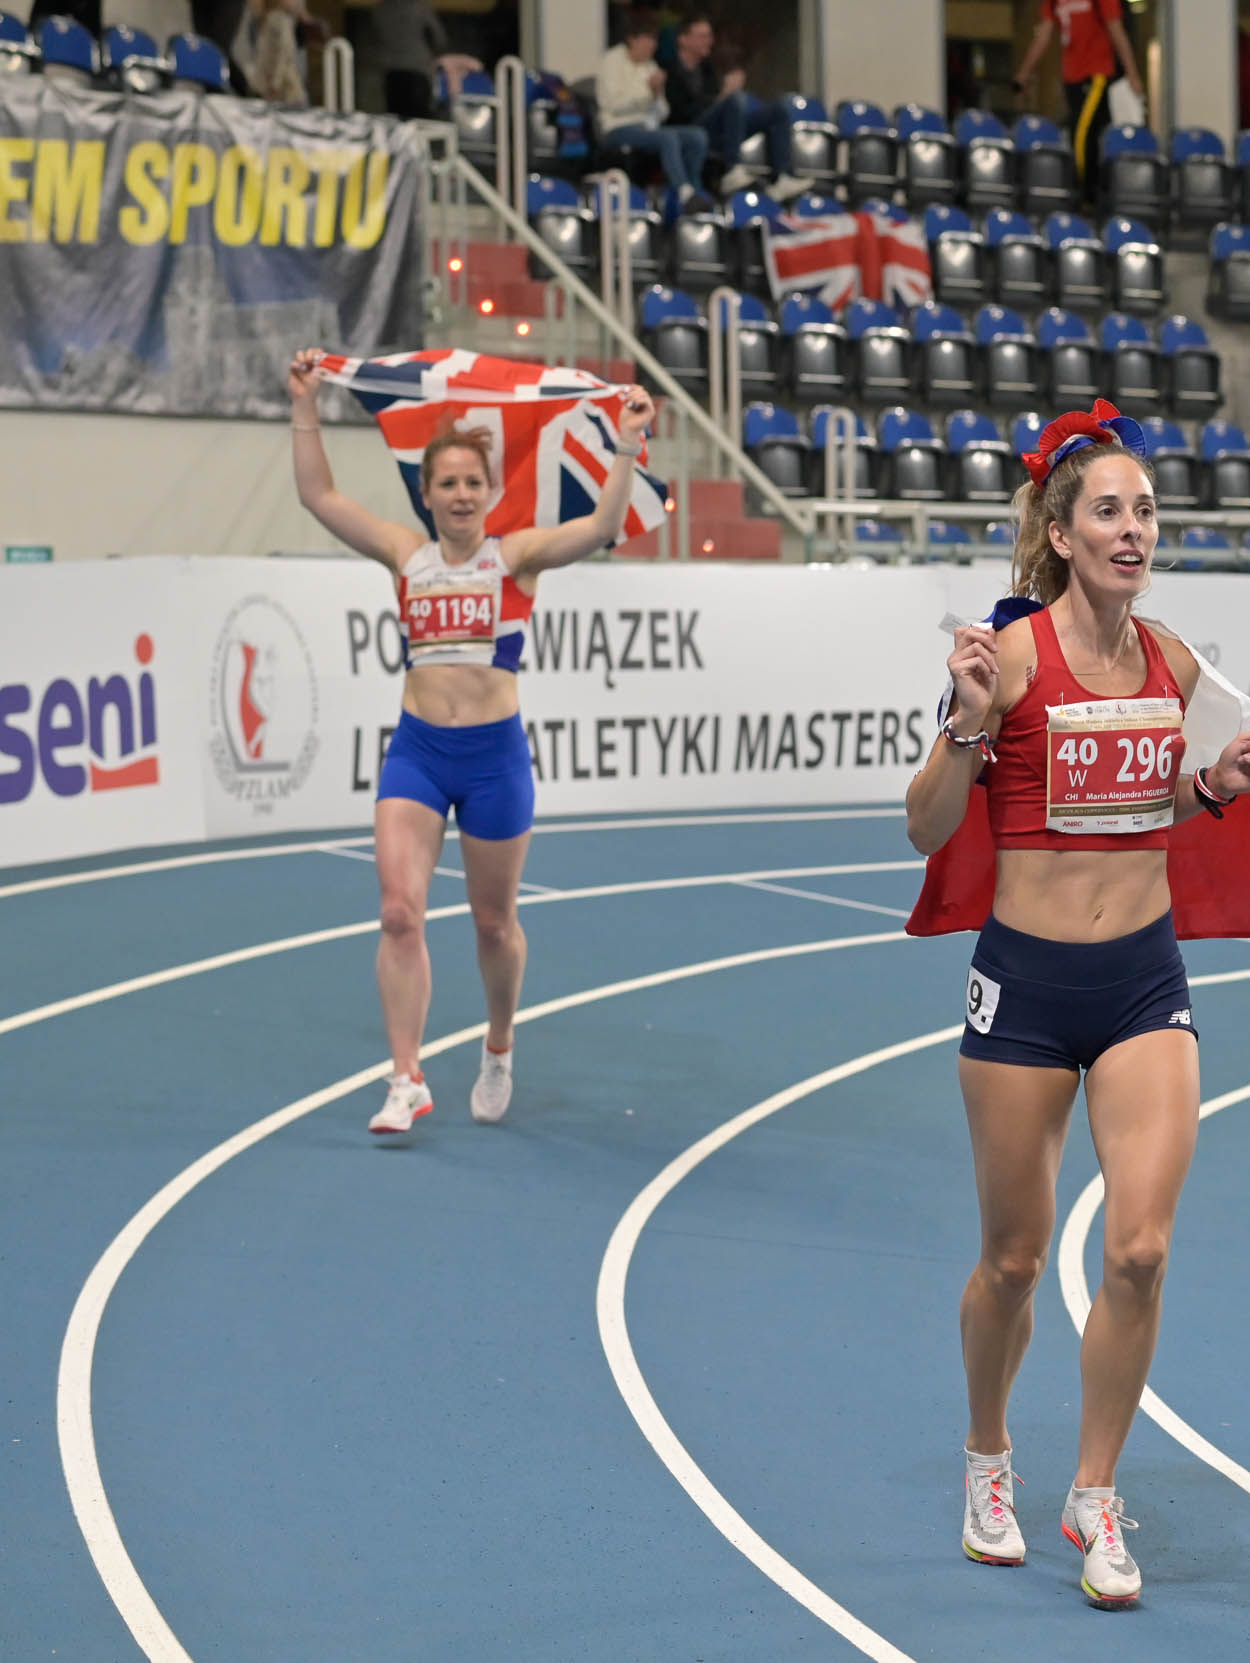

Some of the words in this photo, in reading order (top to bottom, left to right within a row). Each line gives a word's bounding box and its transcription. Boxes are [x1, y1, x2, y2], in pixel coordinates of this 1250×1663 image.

[119, 141, 390, 249] SPORTU
[409, 600, 432, 617] 40
[436, 597, 492, 627] 1194
[519, 611, 704, 689] WIĄZEK
[0, 632, 157, 805] seni
[734, 709, 924, 773] MASTERS
[1057, 738, 1098, 766] 40
[1116, 736, 1174, 783] 296
[1068, 769, 1088, 787] W
[1065, 792, 1079, 801] CHI
[1086, 791, 1107, 801] Maria
[1108, 788, 1142, 800] Alejandra
